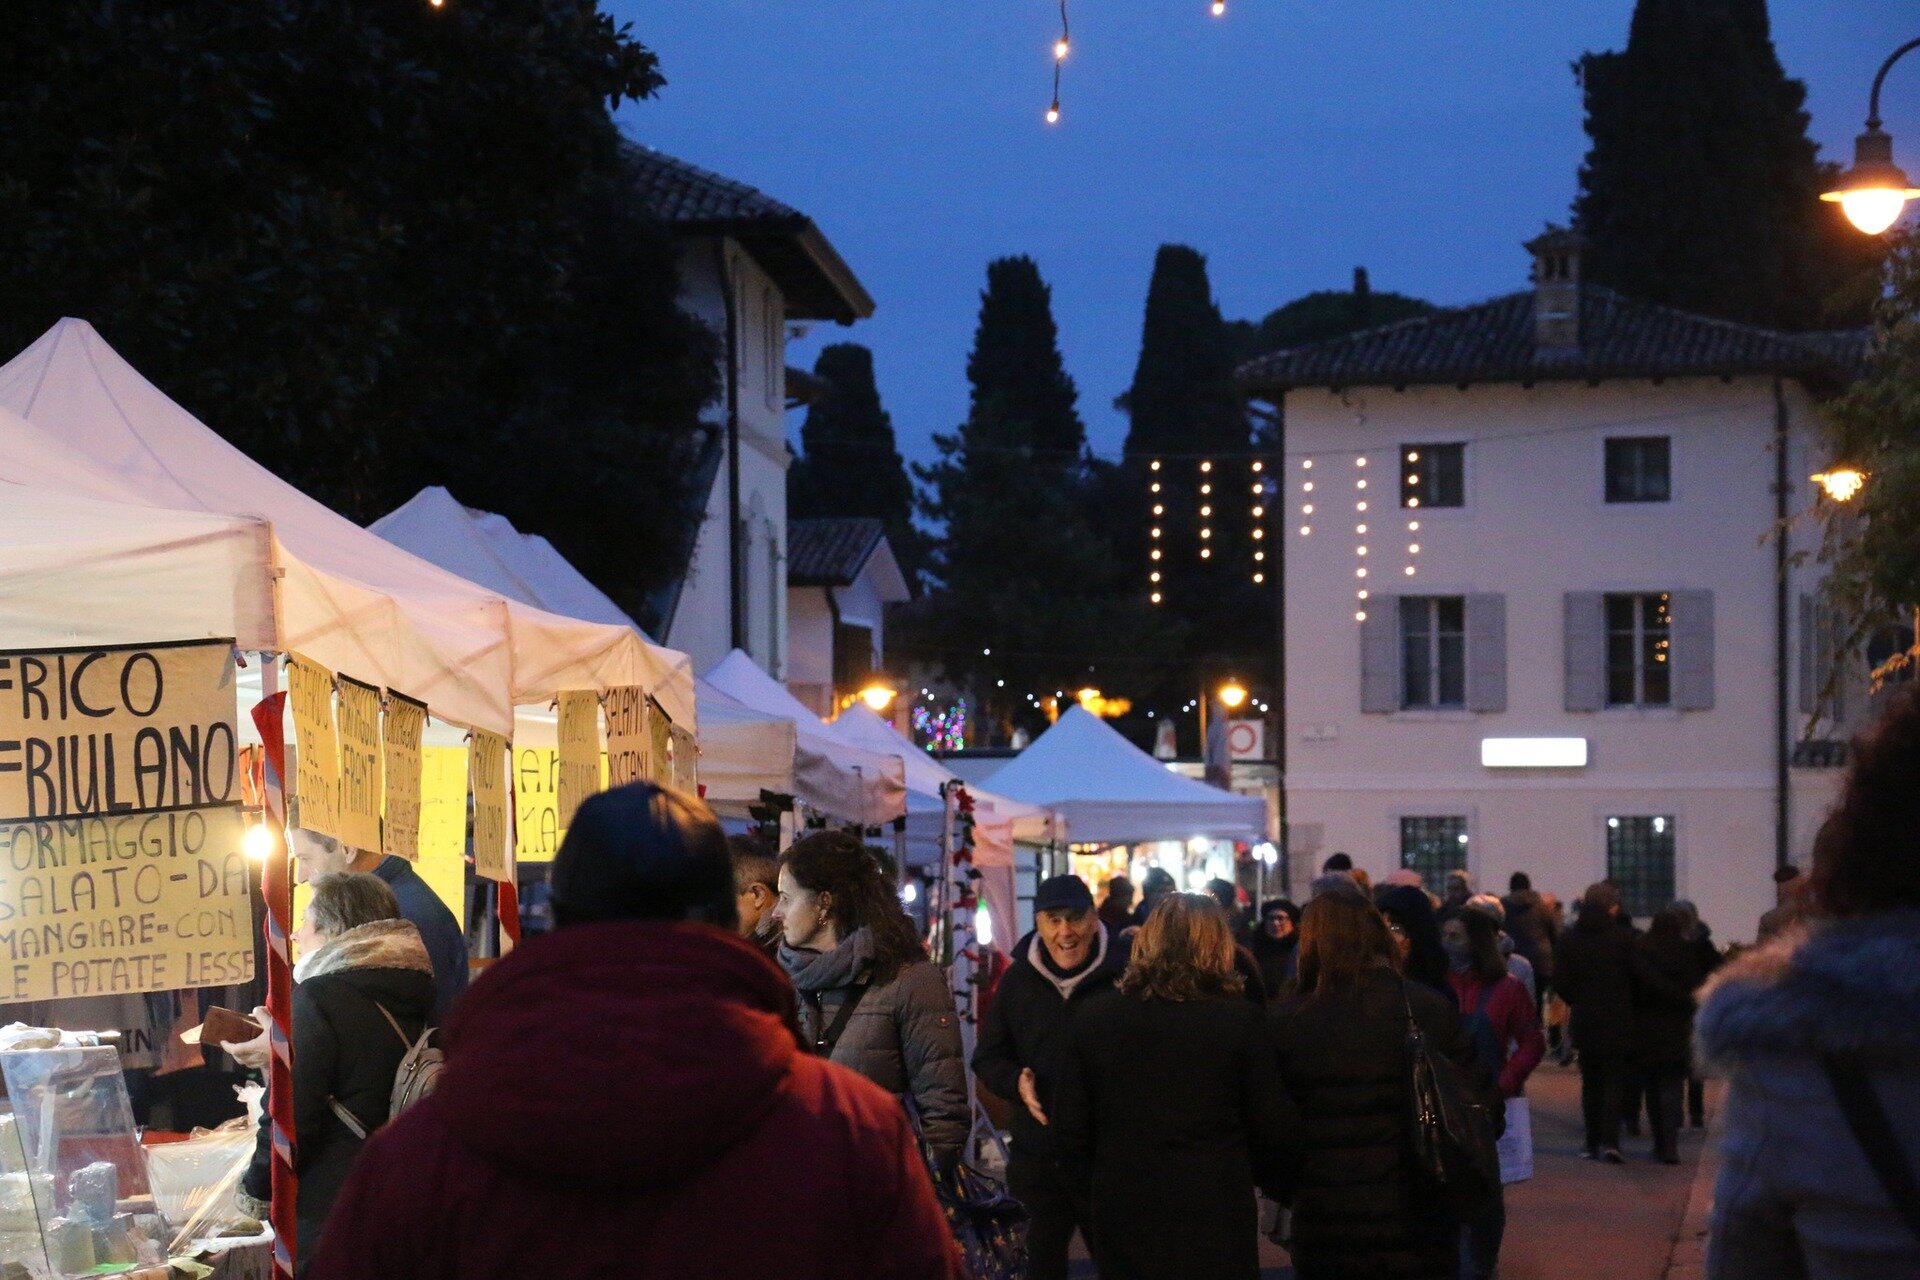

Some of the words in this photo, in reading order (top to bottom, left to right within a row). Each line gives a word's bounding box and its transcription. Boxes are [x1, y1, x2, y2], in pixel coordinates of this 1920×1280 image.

[0, 652, 163, 720] FRICO
[604, 687, 643, 738] SALAMI
[0, 722, 234, 818] FRIULANO
[0, 812, 207, 871] FORMAGGIO
[52, 953, 167, 997] PATATE
[186, 949, 253, 985] LESSE
